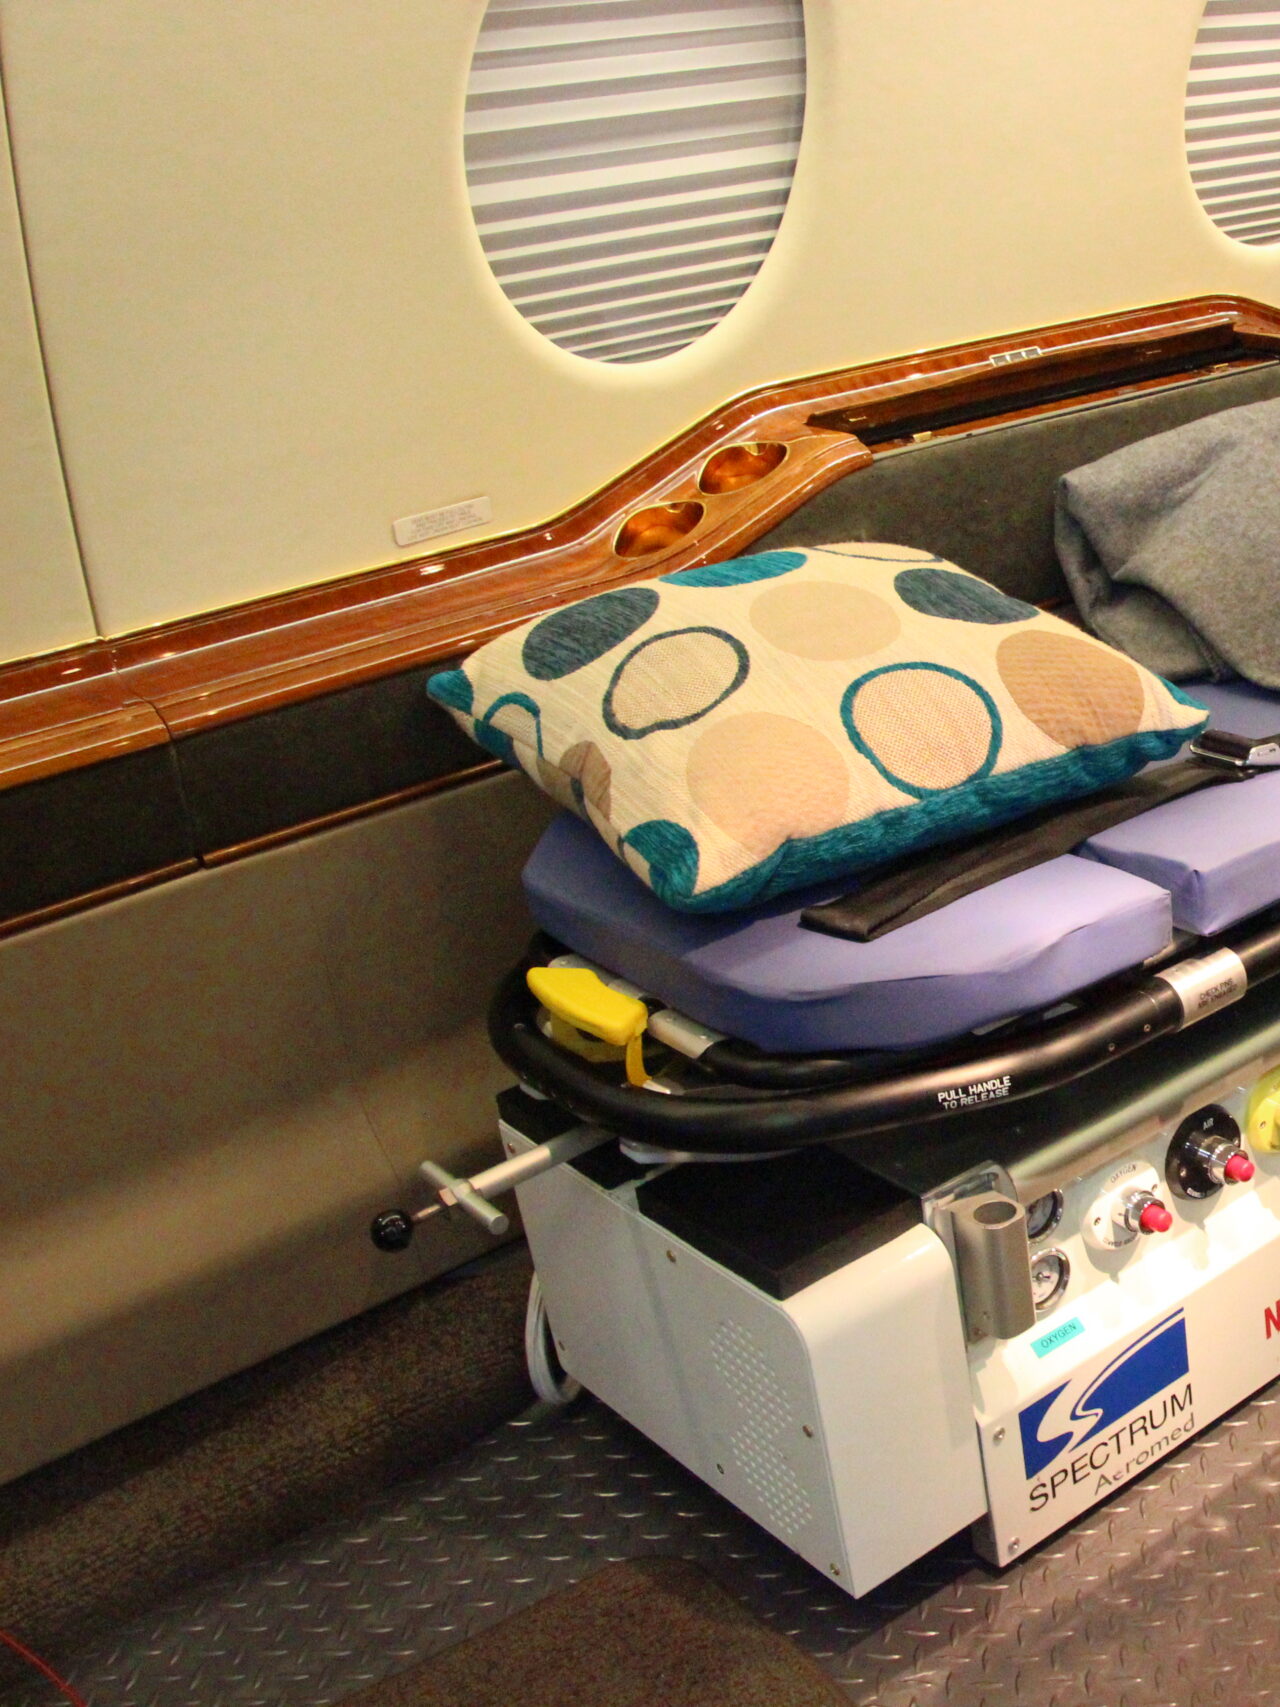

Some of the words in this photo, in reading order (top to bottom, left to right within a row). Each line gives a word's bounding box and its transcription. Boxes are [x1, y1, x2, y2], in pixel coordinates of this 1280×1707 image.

[938, 1088, 966, 1102] PULL
[968, 1075, 1012, 1095] HANDLE
[943, 1101, 958, 1110] TO
[960, 1086, 1010, 1107] RELEASE
[1203, 1117, 1214, 1131] AIR
[1110, 1164, 1137, 1183] OXYGEN
[1040, 1322, 1077, 1348] OXYGEN
[1029, 1383, 1193, 1512] SPECTRUM
[1095, 1412, 1195, 1495] Aeromed
